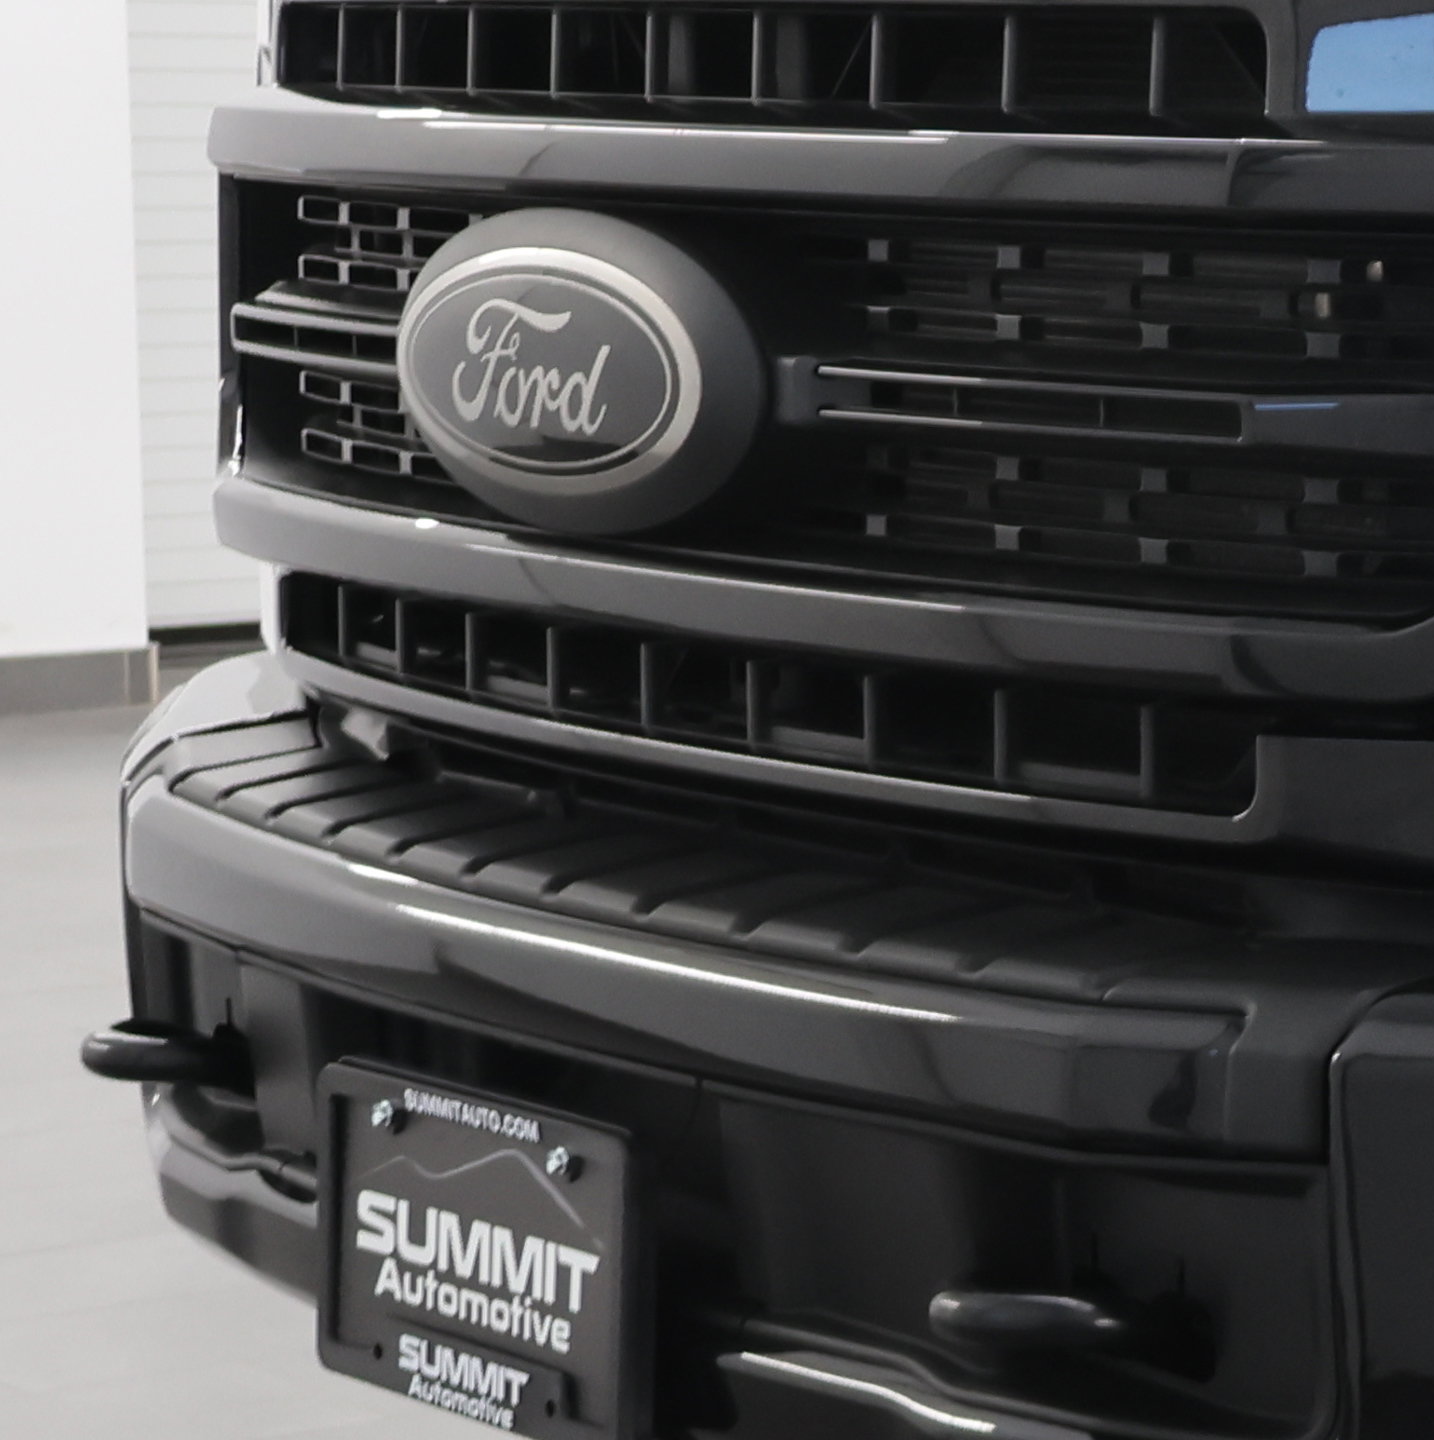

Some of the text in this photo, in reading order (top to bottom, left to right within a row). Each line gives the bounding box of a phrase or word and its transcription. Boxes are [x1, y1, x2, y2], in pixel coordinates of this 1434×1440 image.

[452, 298, 611, 437] Ford
[404, 1088, 541, 1143] SUMMITAUTO.COM
[356, 1190, 600, 1313] SUMMIT
[374, 1257, 571, 1354] Automotive
[399, 1334, 530, 1407] SUMMIT
[409, 1373, 514, 1430] Automotive
